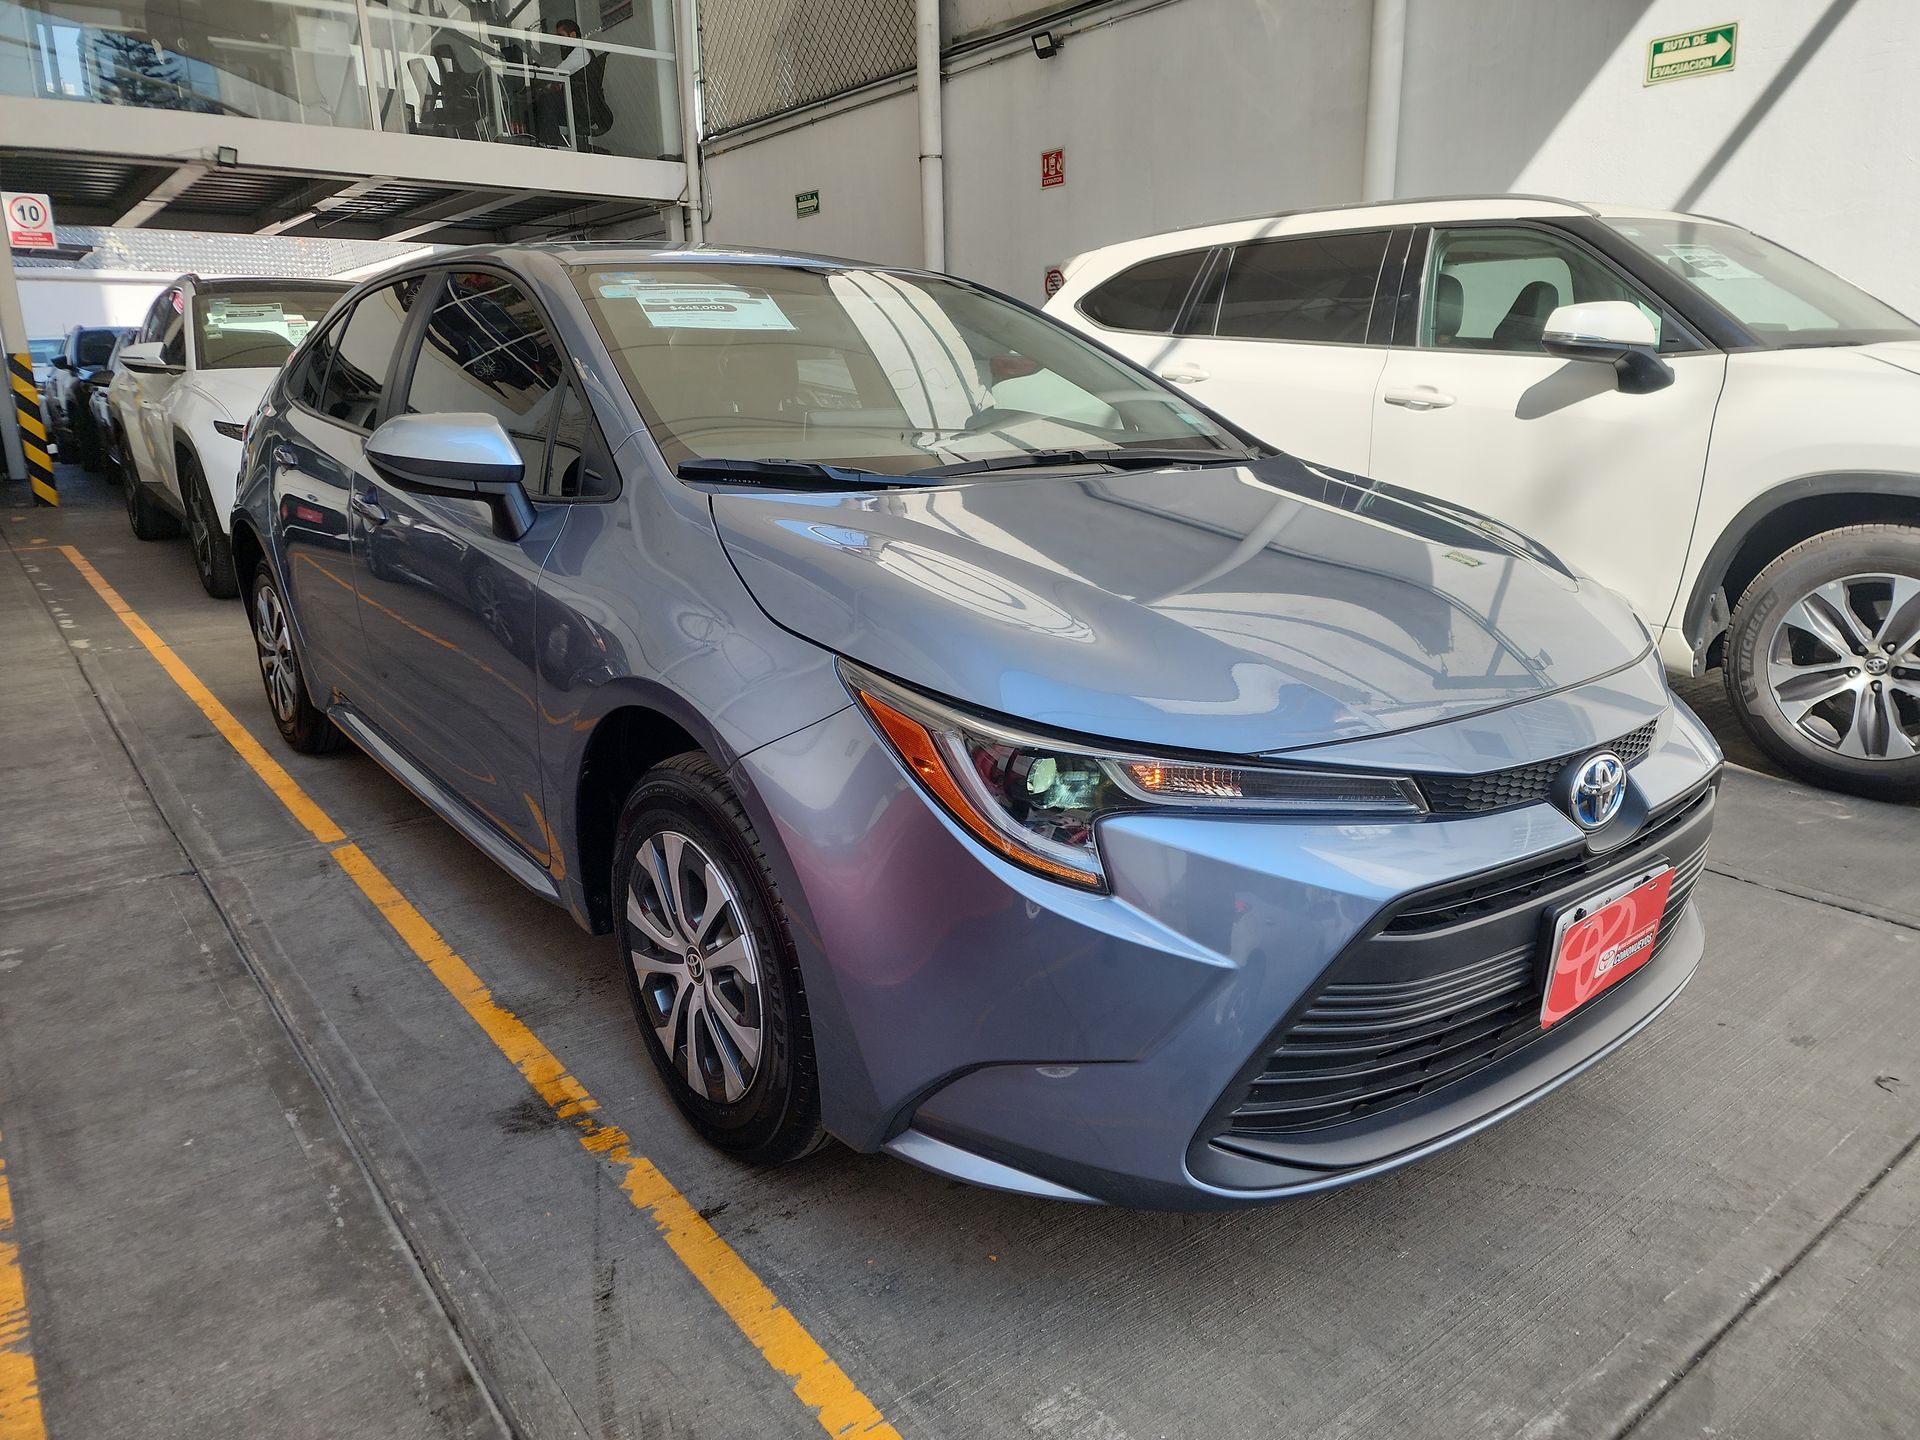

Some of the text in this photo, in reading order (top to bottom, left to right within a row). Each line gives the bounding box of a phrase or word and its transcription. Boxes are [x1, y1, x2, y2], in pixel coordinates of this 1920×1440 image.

[1662, 34, 1708, 52] RUTA DE
[1652, 57, 1713, 78] EVACUACION
[17, 204, 40, 222] 10
[1740, 590, 1778, 673] MICHELIN
[1612, 932, 1653, 966] COMONUEVOS
